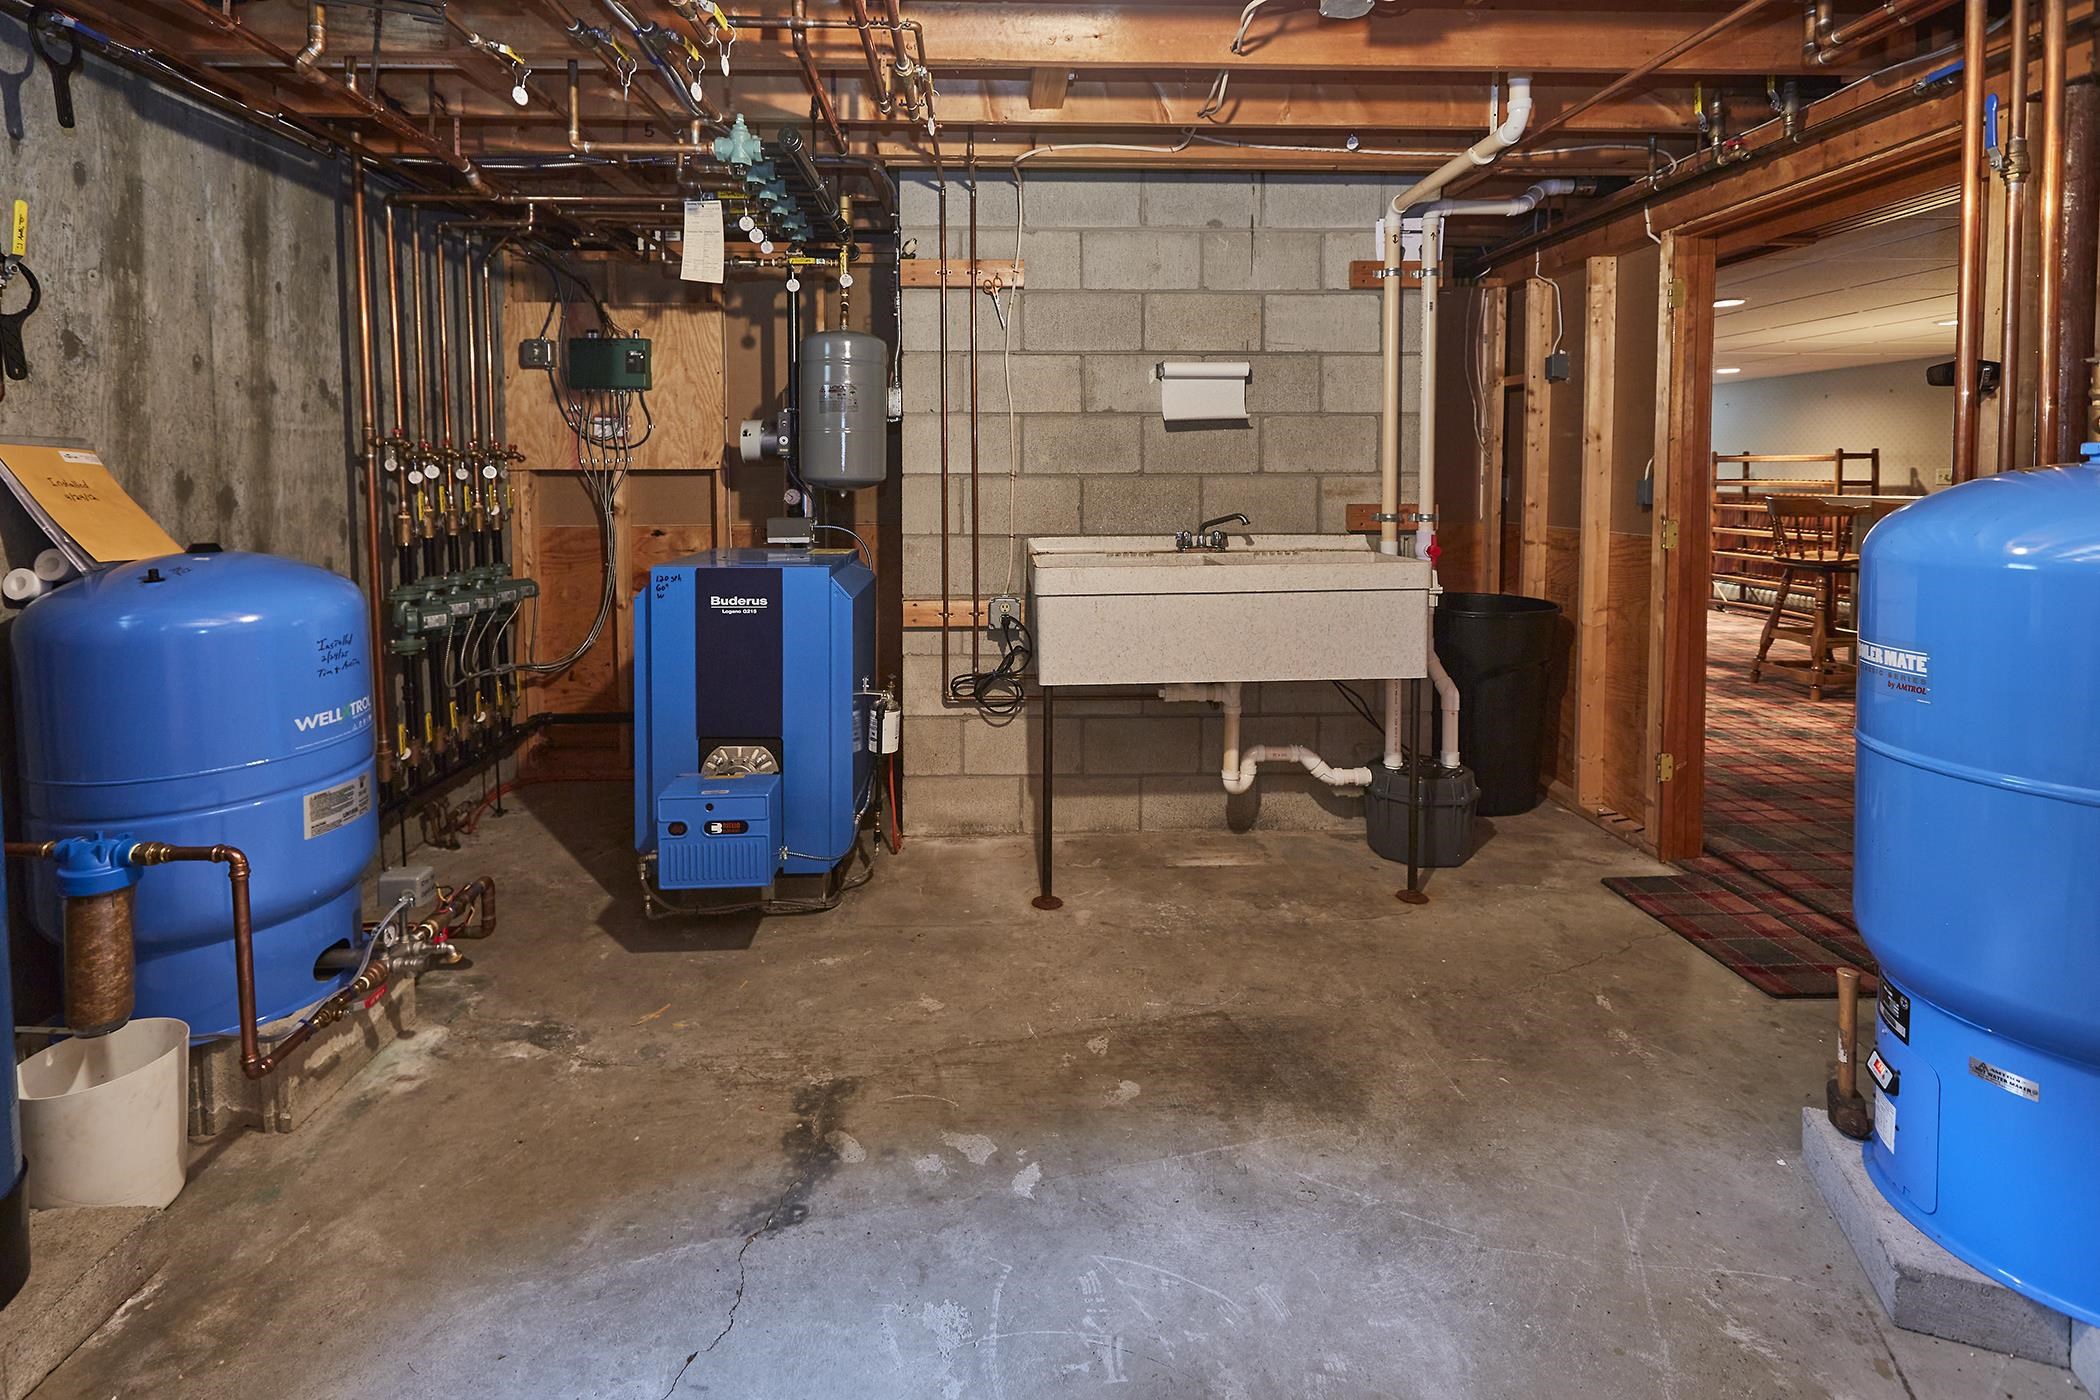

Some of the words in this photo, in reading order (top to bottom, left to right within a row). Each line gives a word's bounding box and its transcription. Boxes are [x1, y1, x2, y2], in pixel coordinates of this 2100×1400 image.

[710, 596, 768, 606] Buderus
[1884, 650, 1927, 673] MATE
[1887, 680, 1896, 689] by
[1896, 682, 1928, 695] AMTROL
